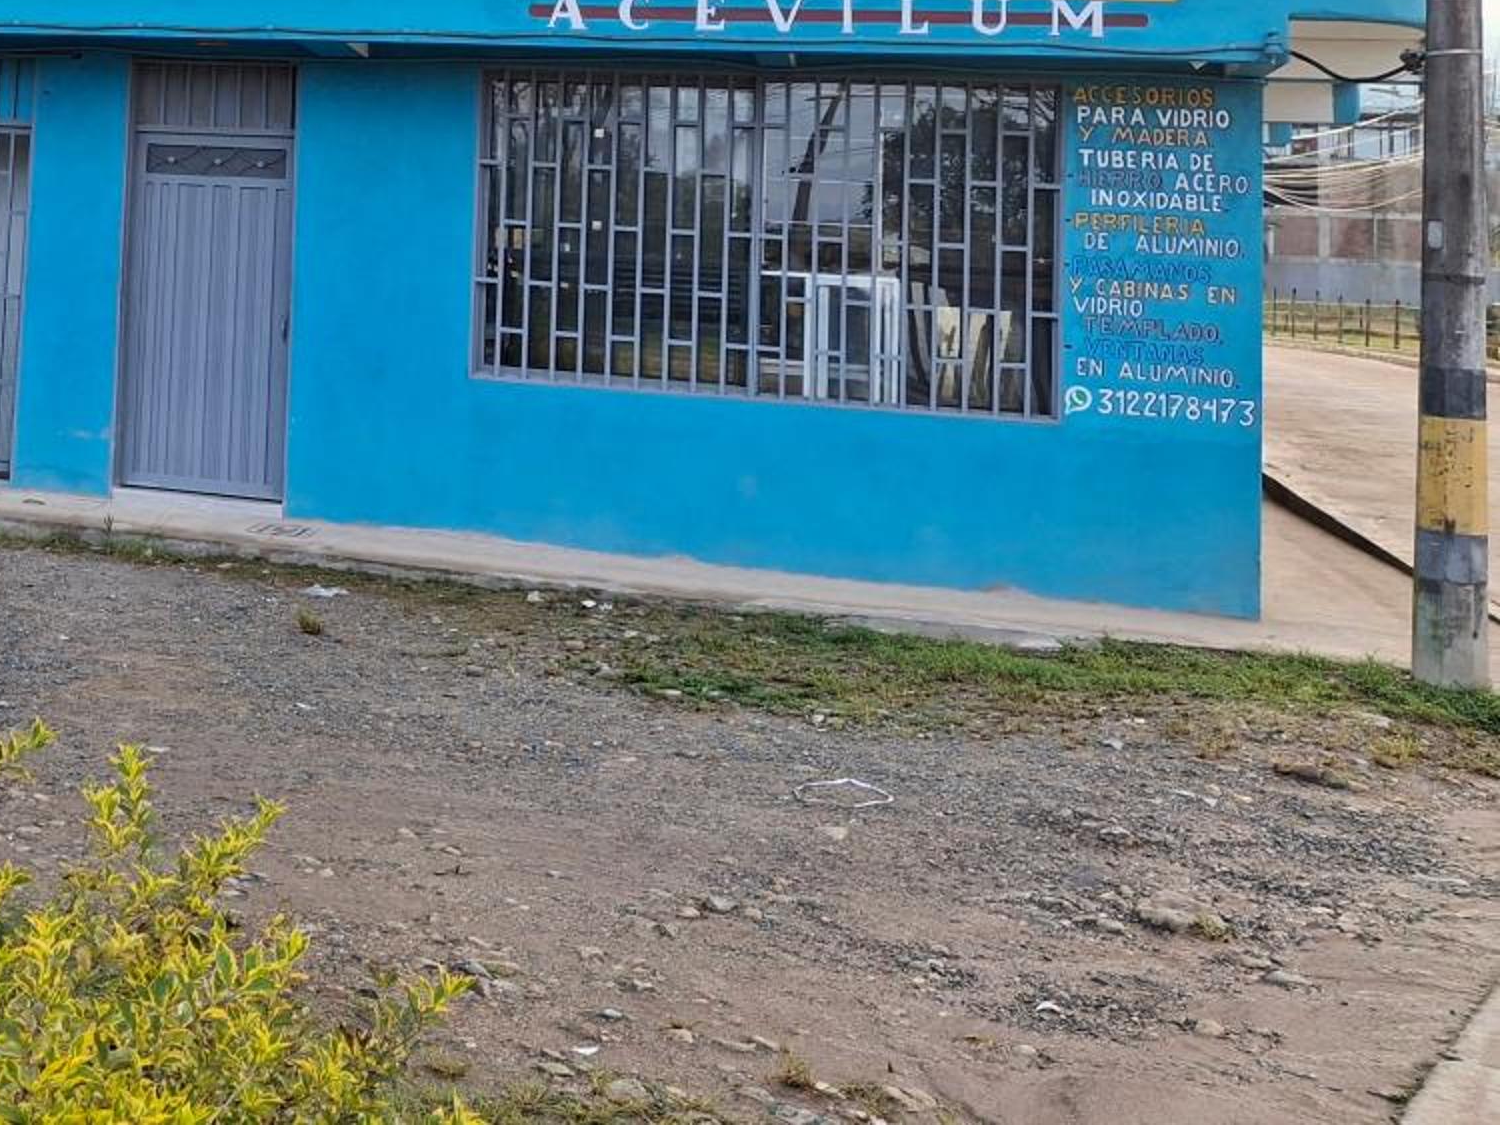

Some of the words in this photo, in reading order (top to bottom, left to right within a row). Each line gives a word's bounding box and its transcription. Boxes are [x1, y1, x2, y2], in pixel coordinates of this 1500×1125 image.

[1077, 106, 1145, 125] PARA
[1156, 108, 1230, 128] VIDRIO
[1080, 126, 1094, 142] Y
[1111, 127, 1208, 147] MADERA
[1079, 149, 1179, 170] TUBERIA
[1190, 153, 1213, 172] DE
[1079, 170, 1163, 189] HIERRO
[1074, 212, 1206, 236] PERFILERIA
[1084, 232, 1109, 250] DE
[1072, 257, 1212, 283] PASAMANOS
[1070, 277, 1083, 294] Y
[1096, 278, 1189, 300] CABINAS
[1207, 286, 1236, 304] EN
[1074, 296, 1144, 317] VIDRIO
[1085, 337, 1205, 365] VENTANAS
[1076, 357, 1105, 376] EN
[1098, 388, 1256, 426] 3122178473
